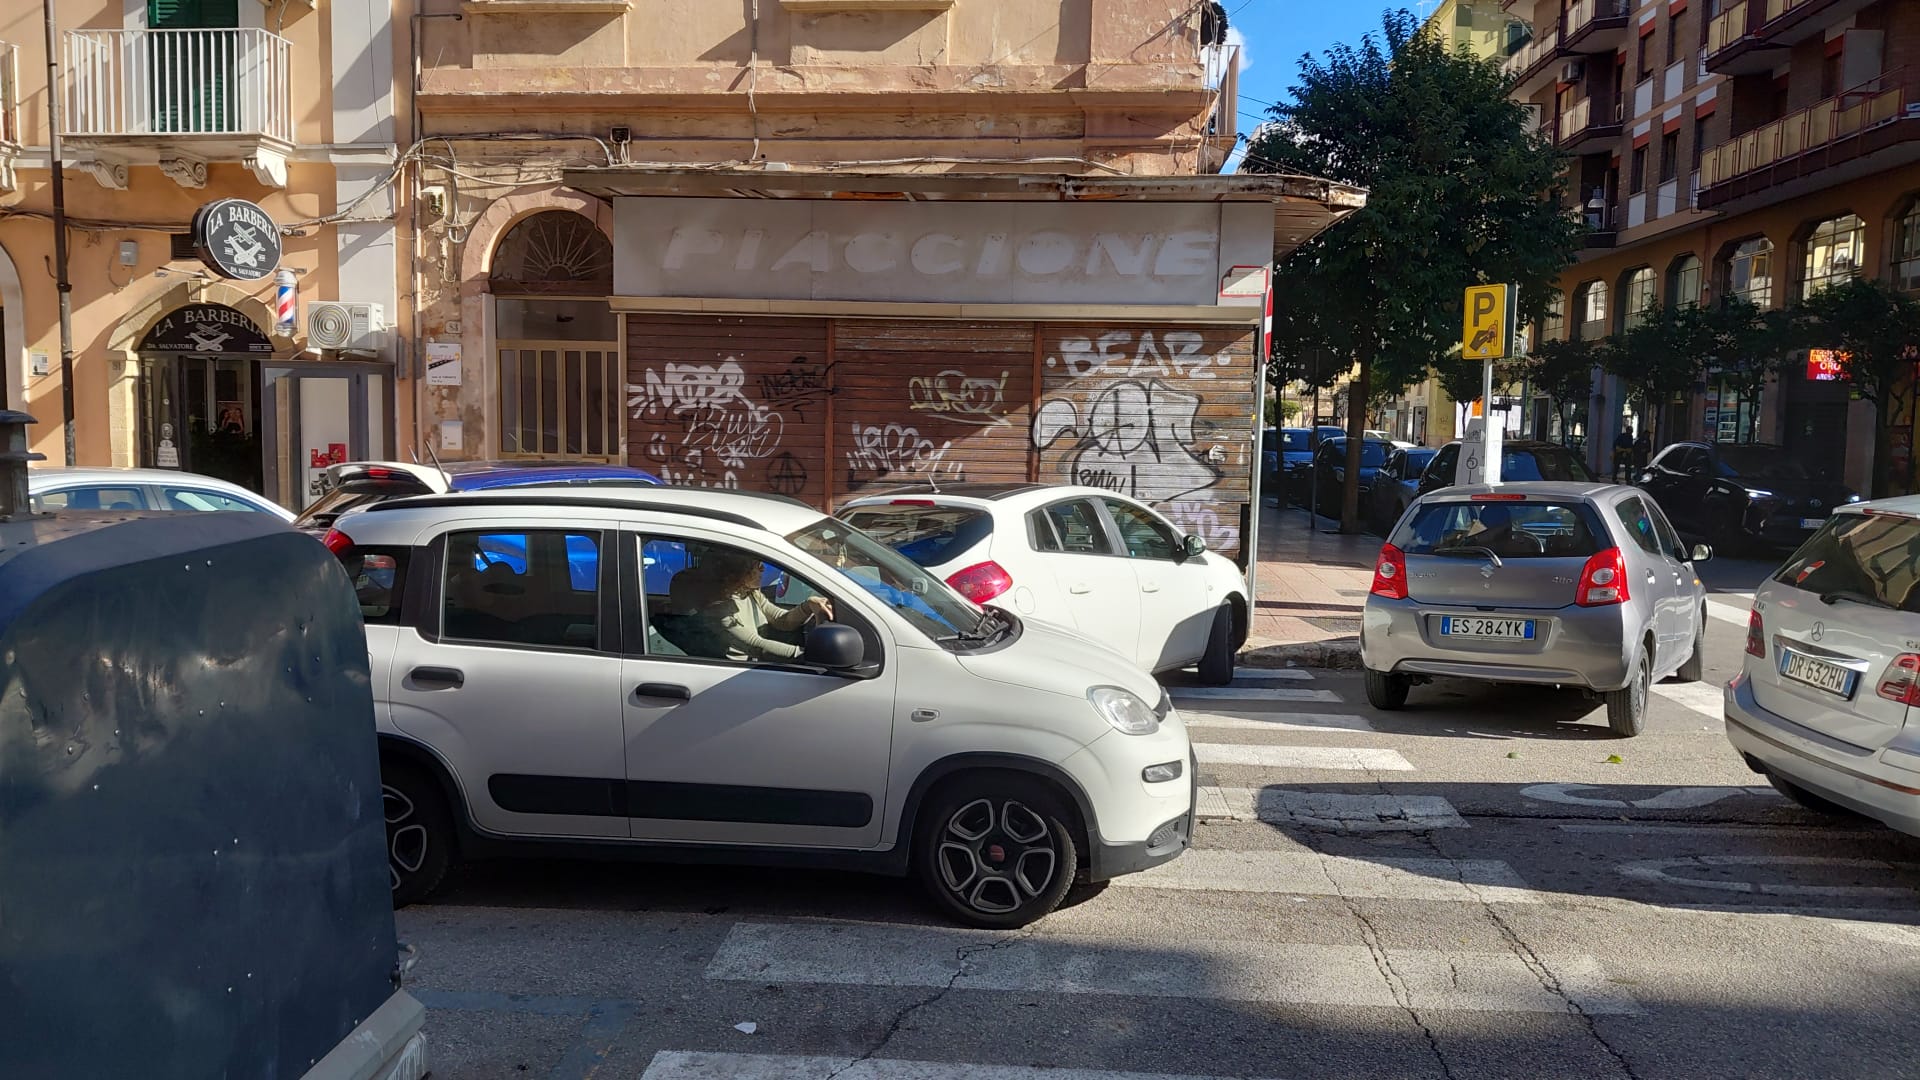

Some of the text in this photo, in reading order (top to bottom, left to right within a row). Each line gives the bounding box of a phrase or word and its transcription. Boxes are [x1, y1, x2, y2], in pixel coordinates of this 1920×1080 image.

[210, 206, 279, 250] LA BARBERIA
[661, 229, 1219, 276] PIACCIONE
[155, 308, 267, 340] LA BARBERIA
[1473, 292, 1496, 328] P
[158, 343, 194, 351] SALVATORE
[1452, 619, 1470, 634] ES
[1475, 620, 1522, 637] 284YK
[1788, 654, 1847, 692] DR 632HW
